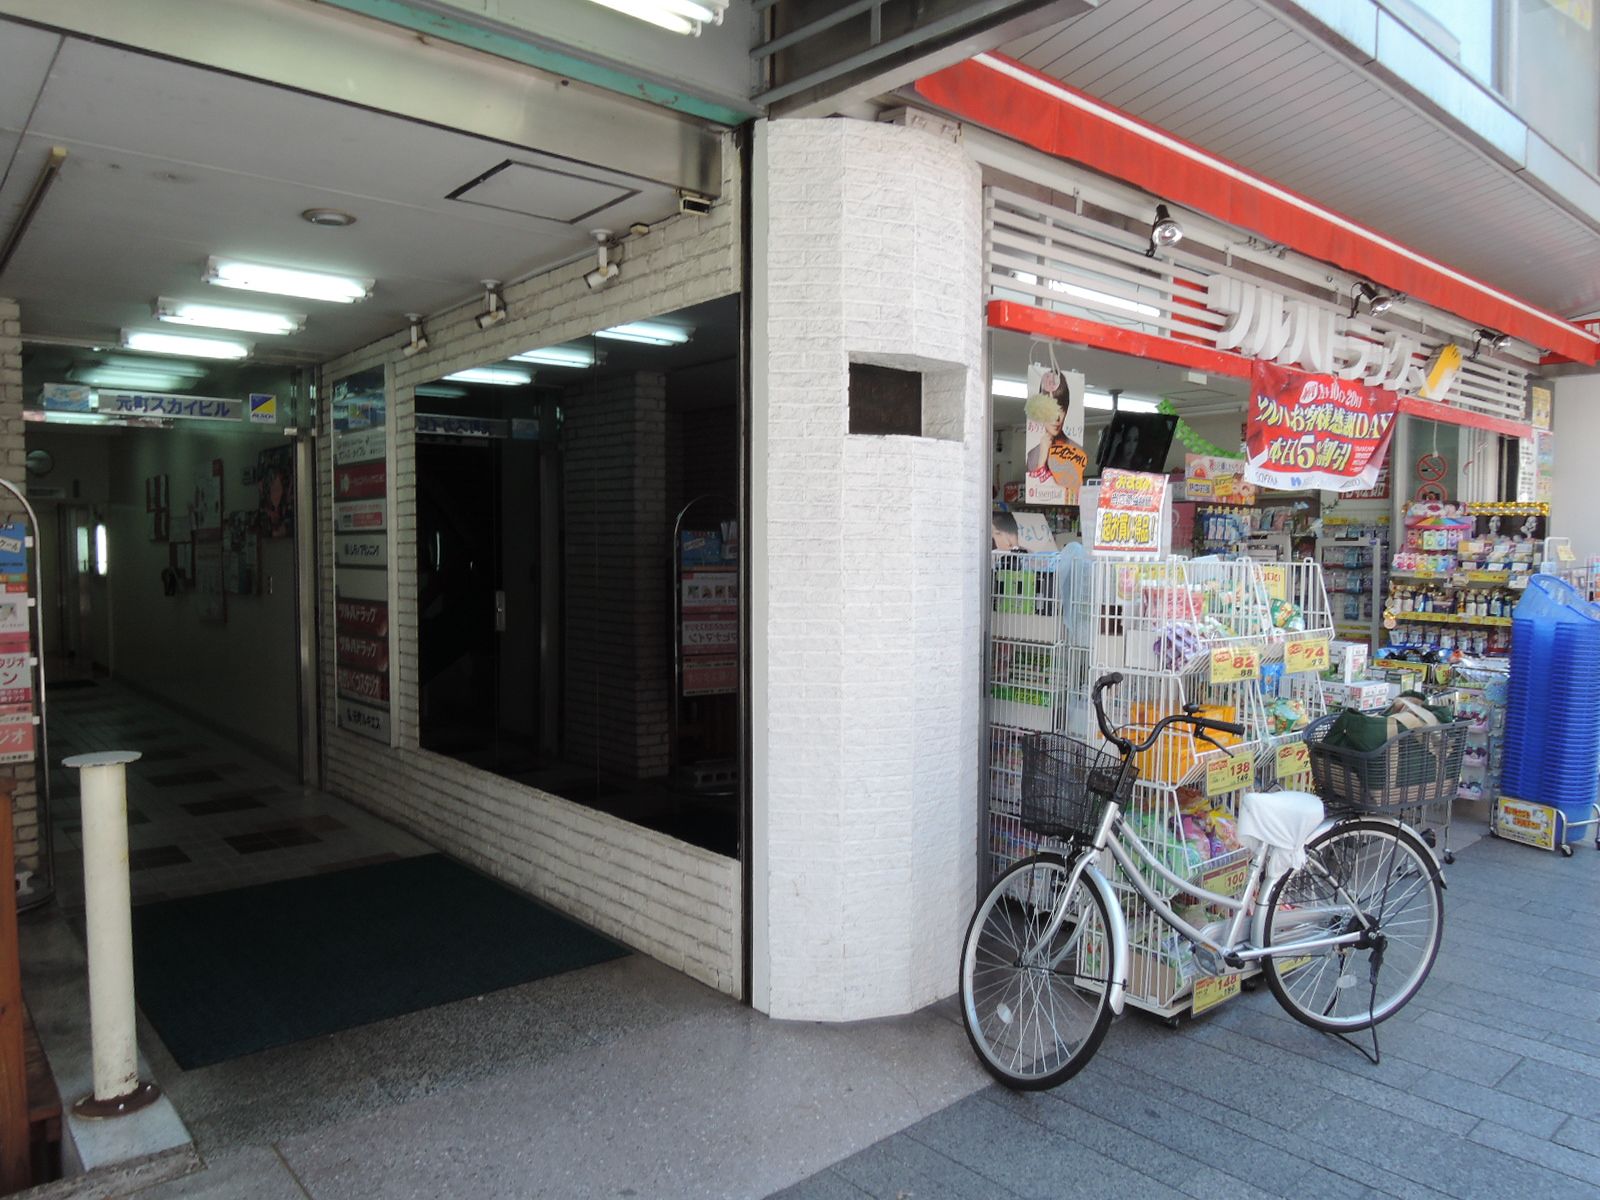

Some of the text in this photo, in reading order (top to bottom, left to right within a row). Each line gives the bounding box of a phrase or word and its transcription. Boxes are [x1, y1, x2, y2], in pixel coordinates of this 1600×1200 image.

[116, 394, 230, 417] 元町スカイビル
[1232, 656, 1256, 669] 82
[1230, 761, 1250, 777] 138
[1226, 871, 1245, 888] 100
